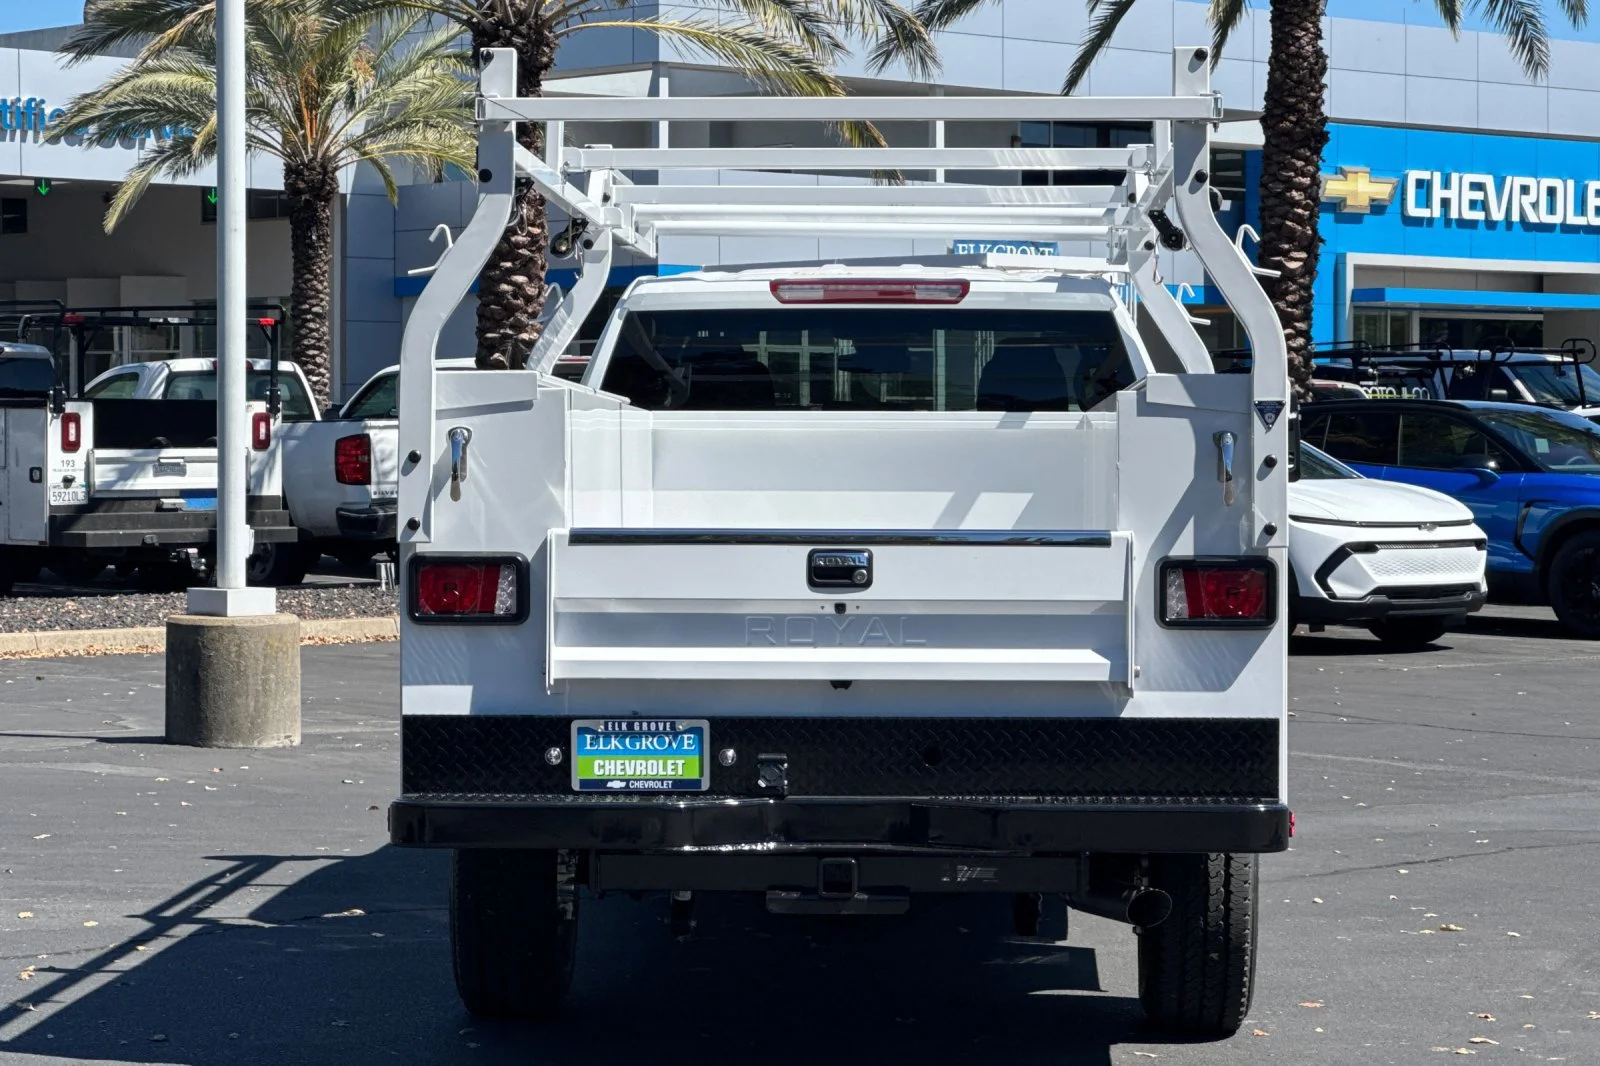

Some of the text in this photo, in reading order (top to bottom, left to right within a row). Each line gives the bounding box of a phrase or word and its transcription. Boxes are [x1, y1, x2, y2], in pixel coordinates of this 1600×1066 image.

[60, 459, 76, 468] 193
[815, 556, 866, 566] ROYAL
[744, 616, 927, 646] ROYAL
[608, 722, 671, 731] ELK GROVE
[593, 759, 685, 776] CHEVROLET
[629, 780, 673, 789] CHEVROLET
